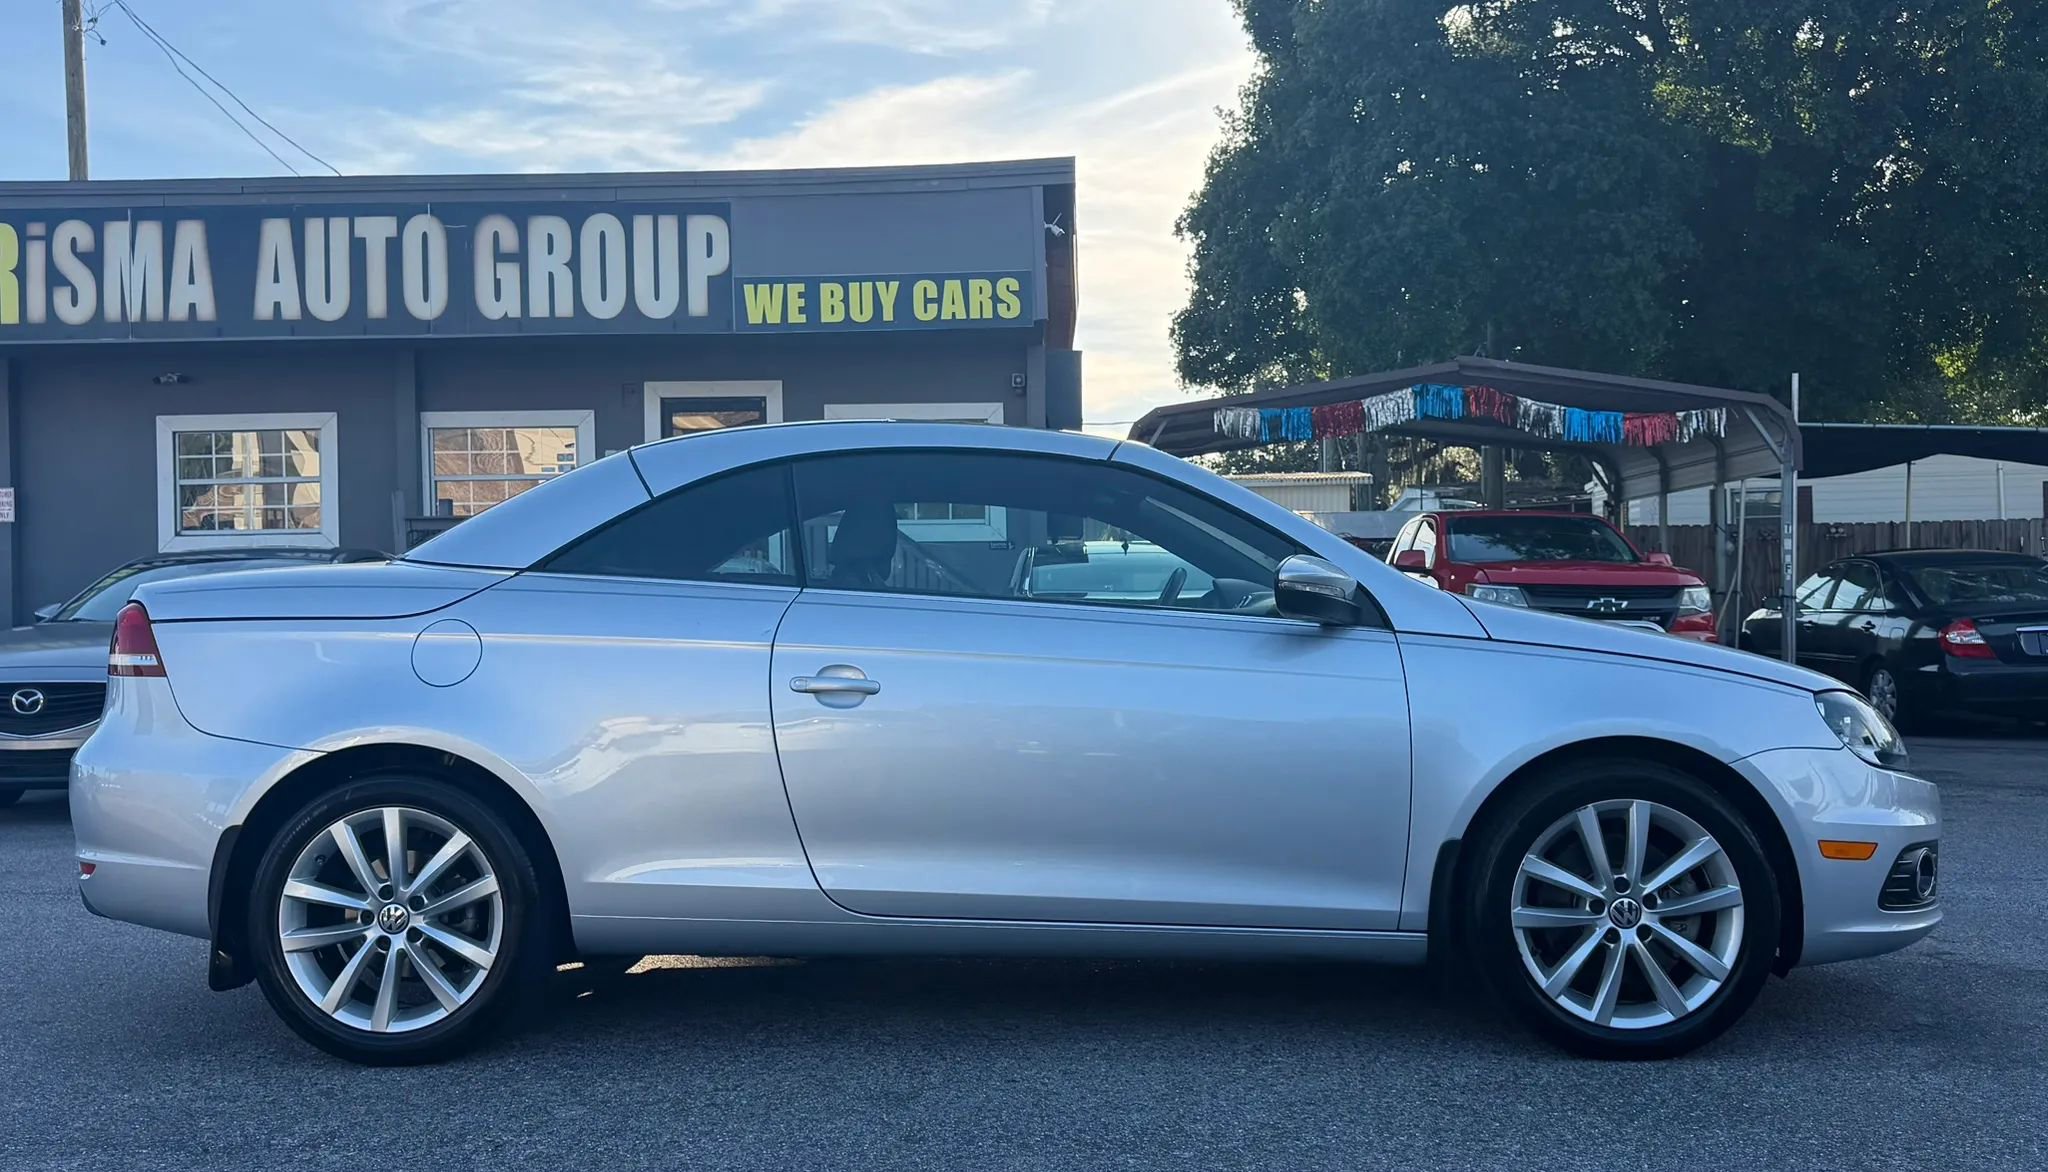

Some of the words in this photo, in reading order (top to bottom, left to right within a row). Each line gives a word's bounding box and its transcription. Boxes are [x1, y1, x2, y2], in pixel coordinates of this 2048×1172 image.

[253, 214, 448, 321] AUTO
[474, 213, 730, 320] GROUP
[743, 283, 807, 324] WE
[820, 281, 899, 323] BUY
[913, 277, 1021, 321] CARS
